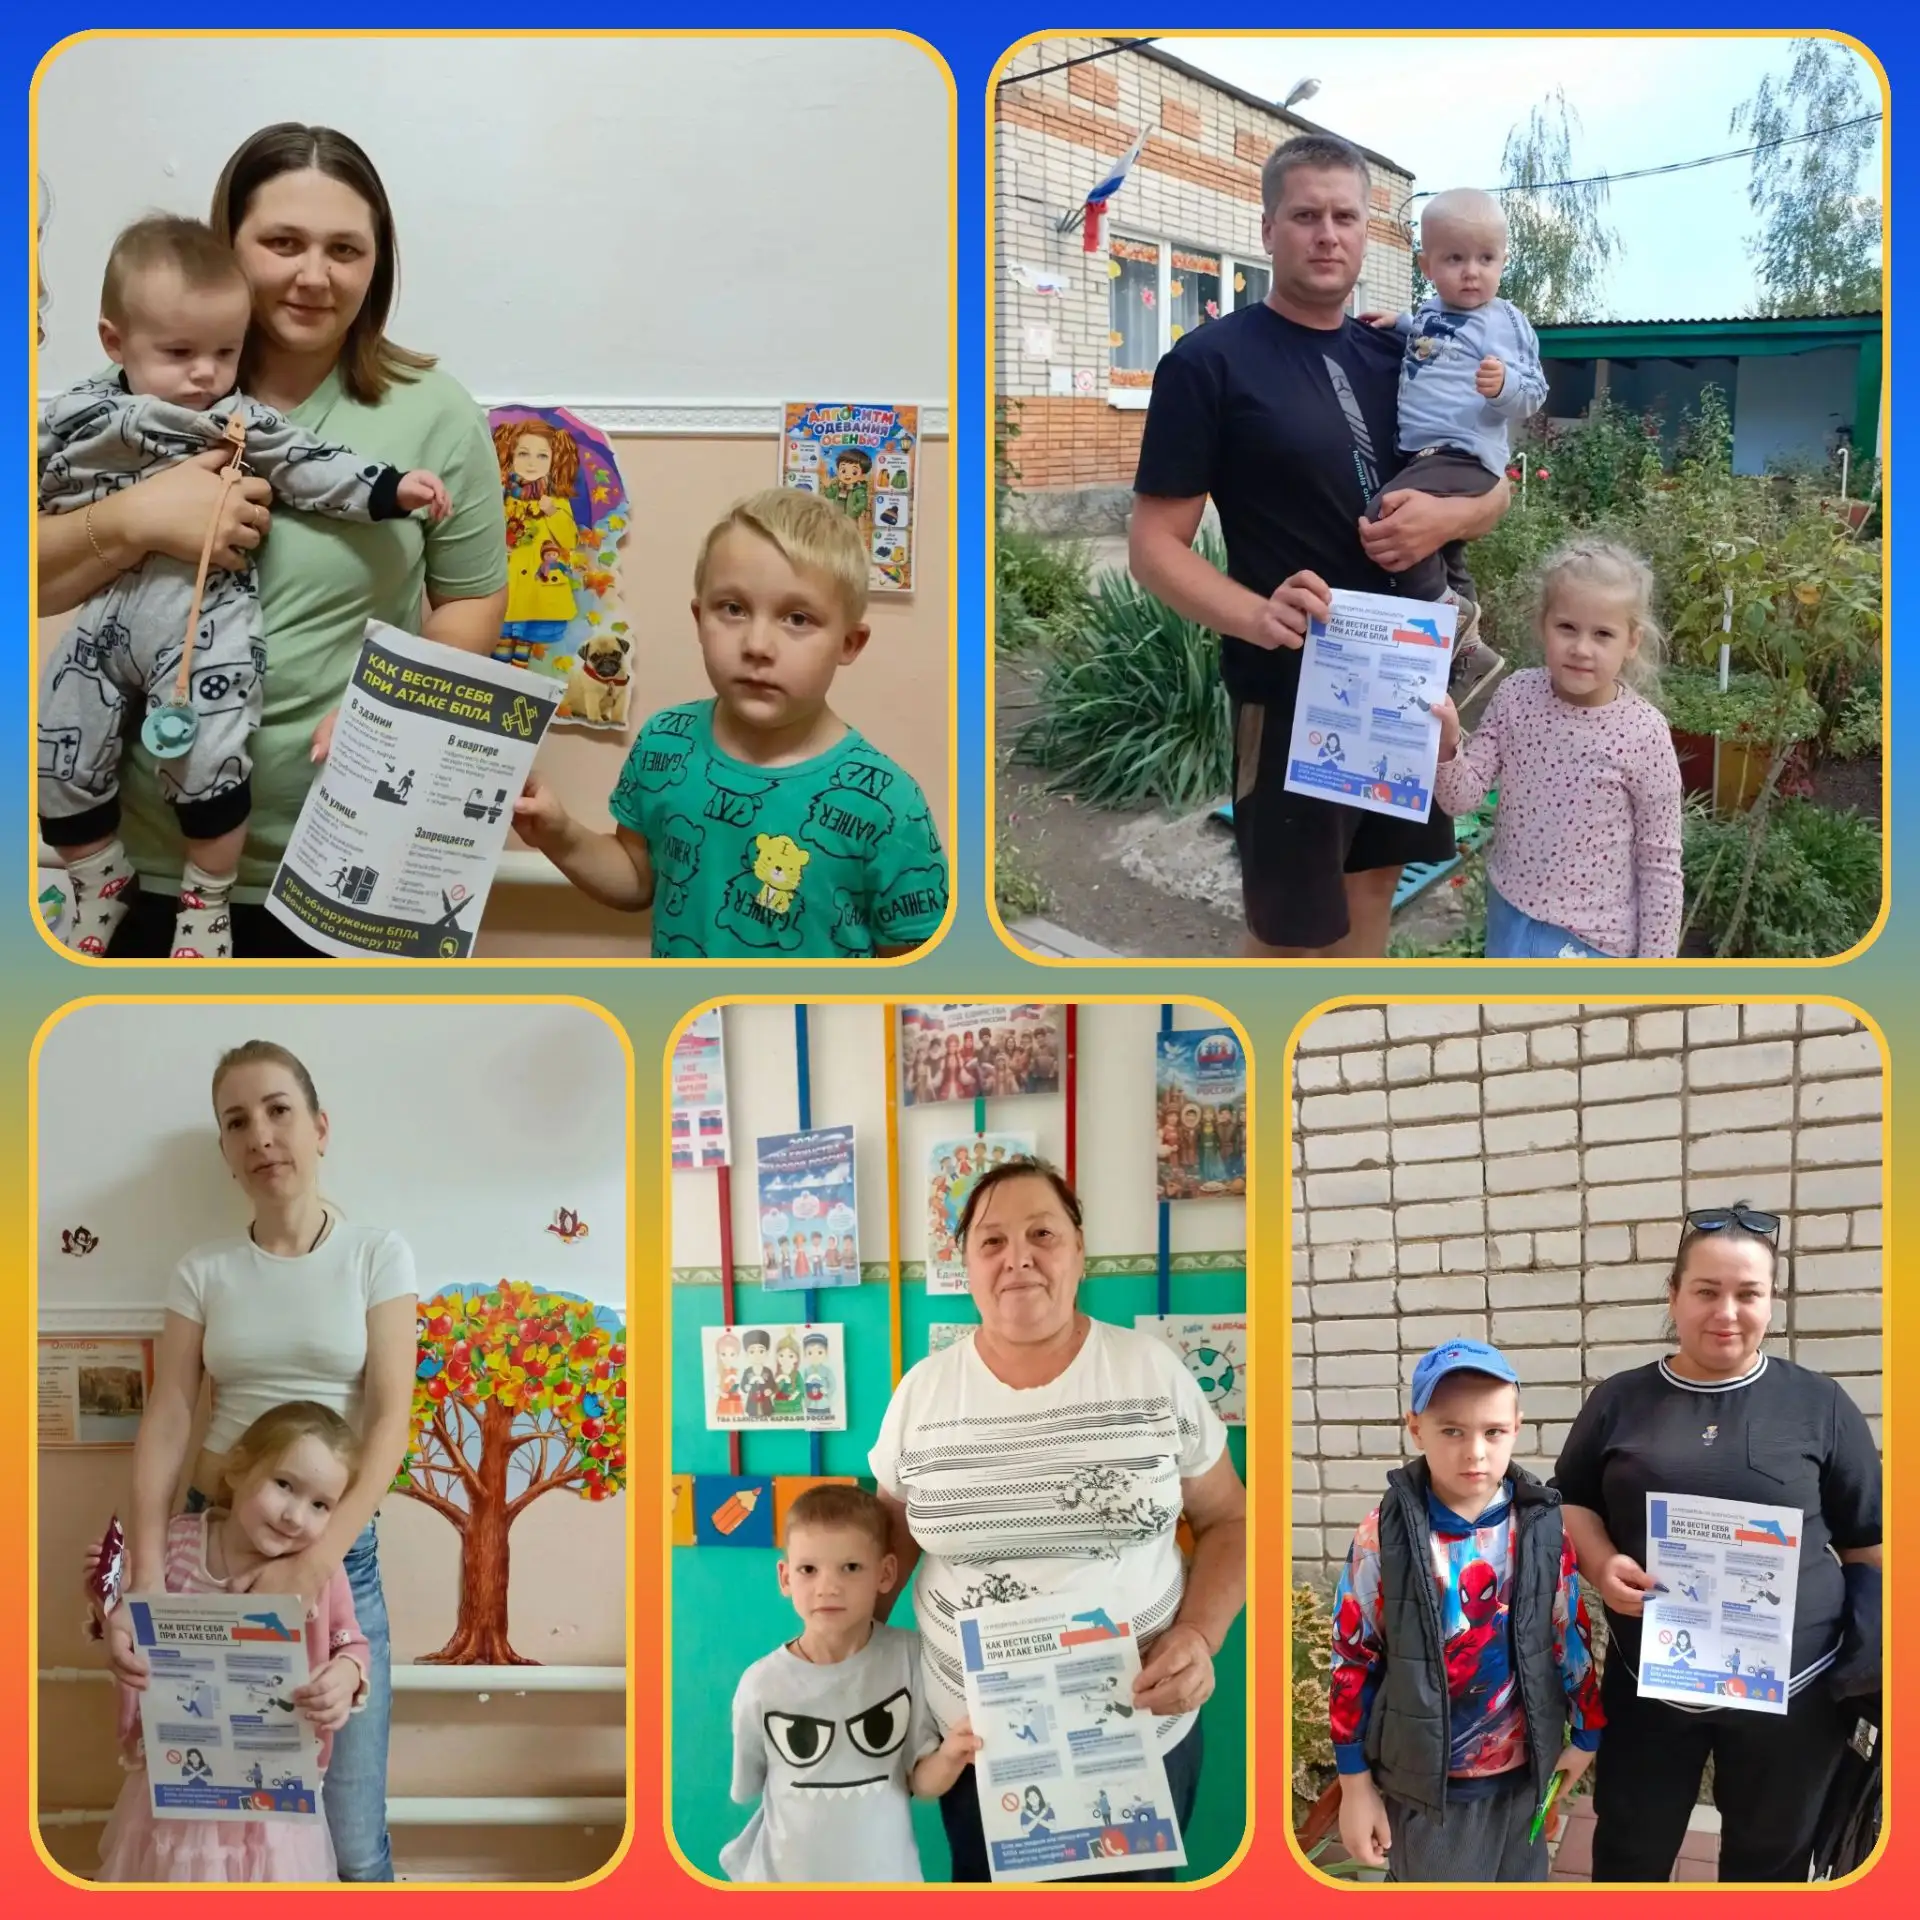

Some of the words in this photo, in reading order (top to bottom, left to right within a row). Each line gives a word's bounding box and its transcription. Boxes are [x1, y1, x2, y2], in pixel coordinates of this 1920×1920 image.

[808, 406, 895, 426] АЛГОРИТМ
[814, 422, 889, 436] ОДЕВАНИЯ
[821, 434, 880, 446] ОСЕНЬЮ
[1352, 450, 1367, 486] formula
[1330, 618, 1344, 626] КАК
[1346, 620, 1369, 629] ВЕСТИ
[1370, 624, 1388, 632] СЕБЯ
[1330, 626, 1344, 634] ПРИ
[1345, 628, 1368, 638] АТАКЕ
[1369, 632, 1389, 641] БПЛА
[368, 652, 400, 678] КАК
[401, 669, 453, 694] ВЕСТИ
[454, 685, 494, 704] СЕБЯ
[362, 669, 392, 695] ПРИ
[394, 687, 448, 711] АТАКЕ
[449, 702, 492, 723] БПЛА
[351, 698, 358, 710] В
[358, 706, 392, 729] здании
[448, 734, 456, 745] В
[456, 739, 499, 757] квартире
[320, 785, 329, 801] На
[329, 798, 357, 819] улице
[415, 826, 475, 847] Запрещается
[285, 877, 303, 898] При
[305, 895, 384, 934] обнаружении
[386, 926, 419, 940] БПЛА
[877, 888, 940, 923] GATHER
[281, 891, 318, 924] звоните
[320, 920, 335, 933] по
[338, 931, 384, 950] номеру
[387, 939, 402, 951] 112
[1687, 1521, 1710, 1530] ВЕСТИ
[1712, 1524, 1729, 1532] СЕБЯ
[1688, 1529, 1710, 1538] АТАКЕ
[1712, 1532, 1731, 1540] БПЛА
[176, 1624, 201, 1632] ВЕСТИ
[178, 1632, 204, 1640] АТАКЕ
[986, 1641, 1002, 1649] КАК
[1003, 1636, 1030, 1648] ВЕСТИ
[1031, 1633, 1052, 1643] СЕБЯ
[987, 1651, 1003, 1660] ПРИ
[1006, 1647, 1033, 1658] АТАКЕ
[1034, 1643, 1057, 1654] БПЛА
